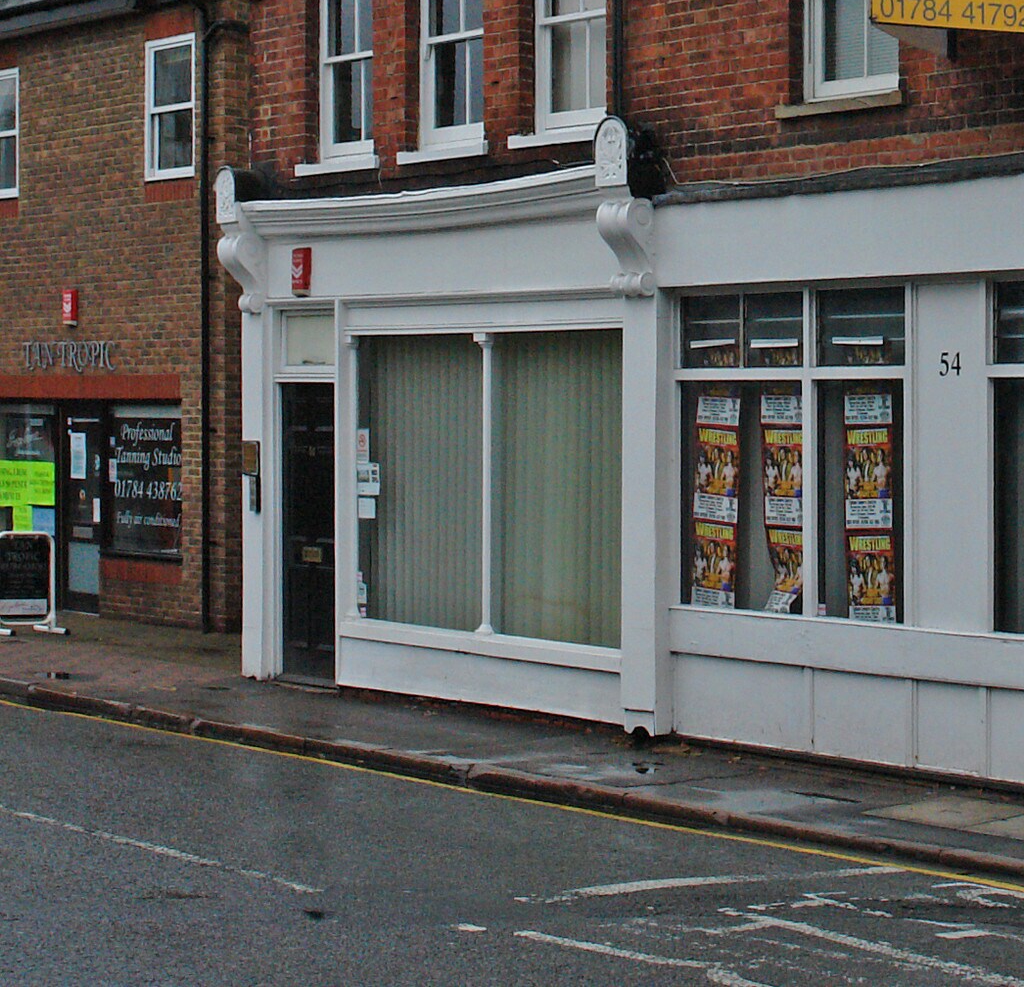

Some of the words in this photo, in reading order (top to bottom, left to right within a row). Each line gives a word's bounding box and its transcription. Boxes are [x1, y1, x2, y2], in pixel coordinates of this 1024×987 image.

[22, 340, 54, 370] TAN
[56, 340, 117, 372] TROPIC
[939, 352, 962, 376] 54
[121, 421, 175, 447] Professional
[699, 427, 737, 446] WRESTLING
[846, 429, 888, 445] WRESTLING
[115, 445, 151, 471] Tanning
[152, 446, 182, 467] Studio
[114, 479, 144, 499] 01784
[146, 481, 182, 501] 438762
[849, 536, 891, 551] WRESTLING
